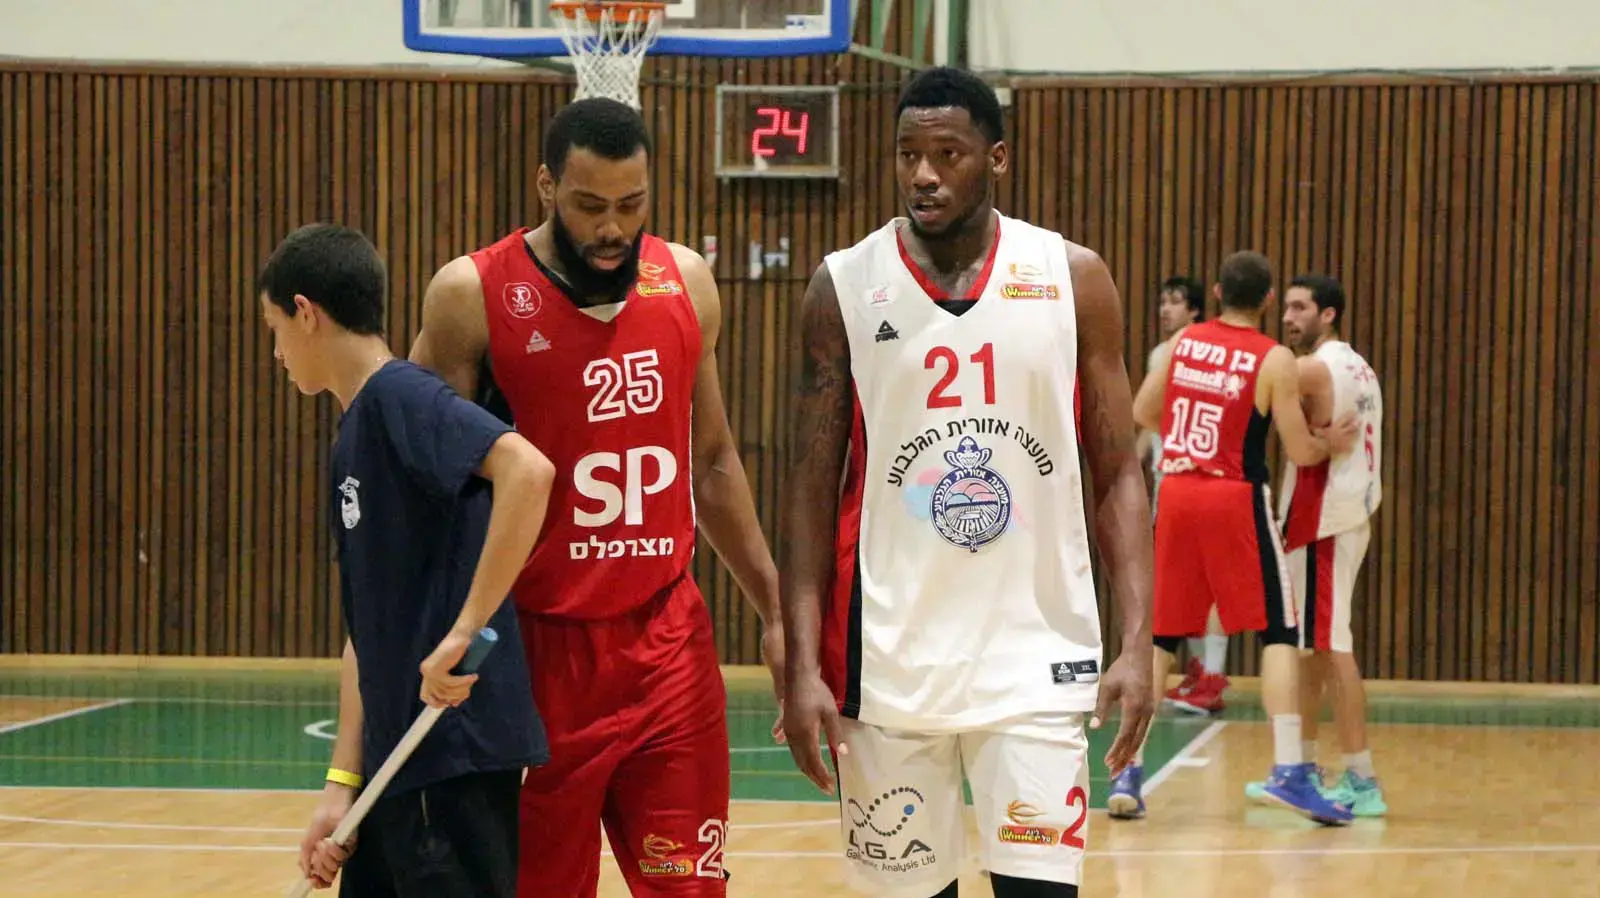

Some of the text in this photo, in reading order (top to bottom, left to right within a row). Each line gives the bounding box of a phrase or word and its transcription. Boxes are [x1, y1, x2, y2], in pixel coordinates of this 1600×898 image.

[751, 107, 808, 156] 24
[583, 349, 663, 422] 25
[924, 342, 996, 409] 21
[1175, 338, 1257, 372] בן משה
[887, 417, 1054, 487] מועצה אזורית הגלבוע
[1164, 397, 1224, 460] 15
[573, 445, 678, 527] SP
[697, 818, 728, 879] 2
[881, 859, 919, 872] Analysis
[921, 854, 936, 866] Ltd
